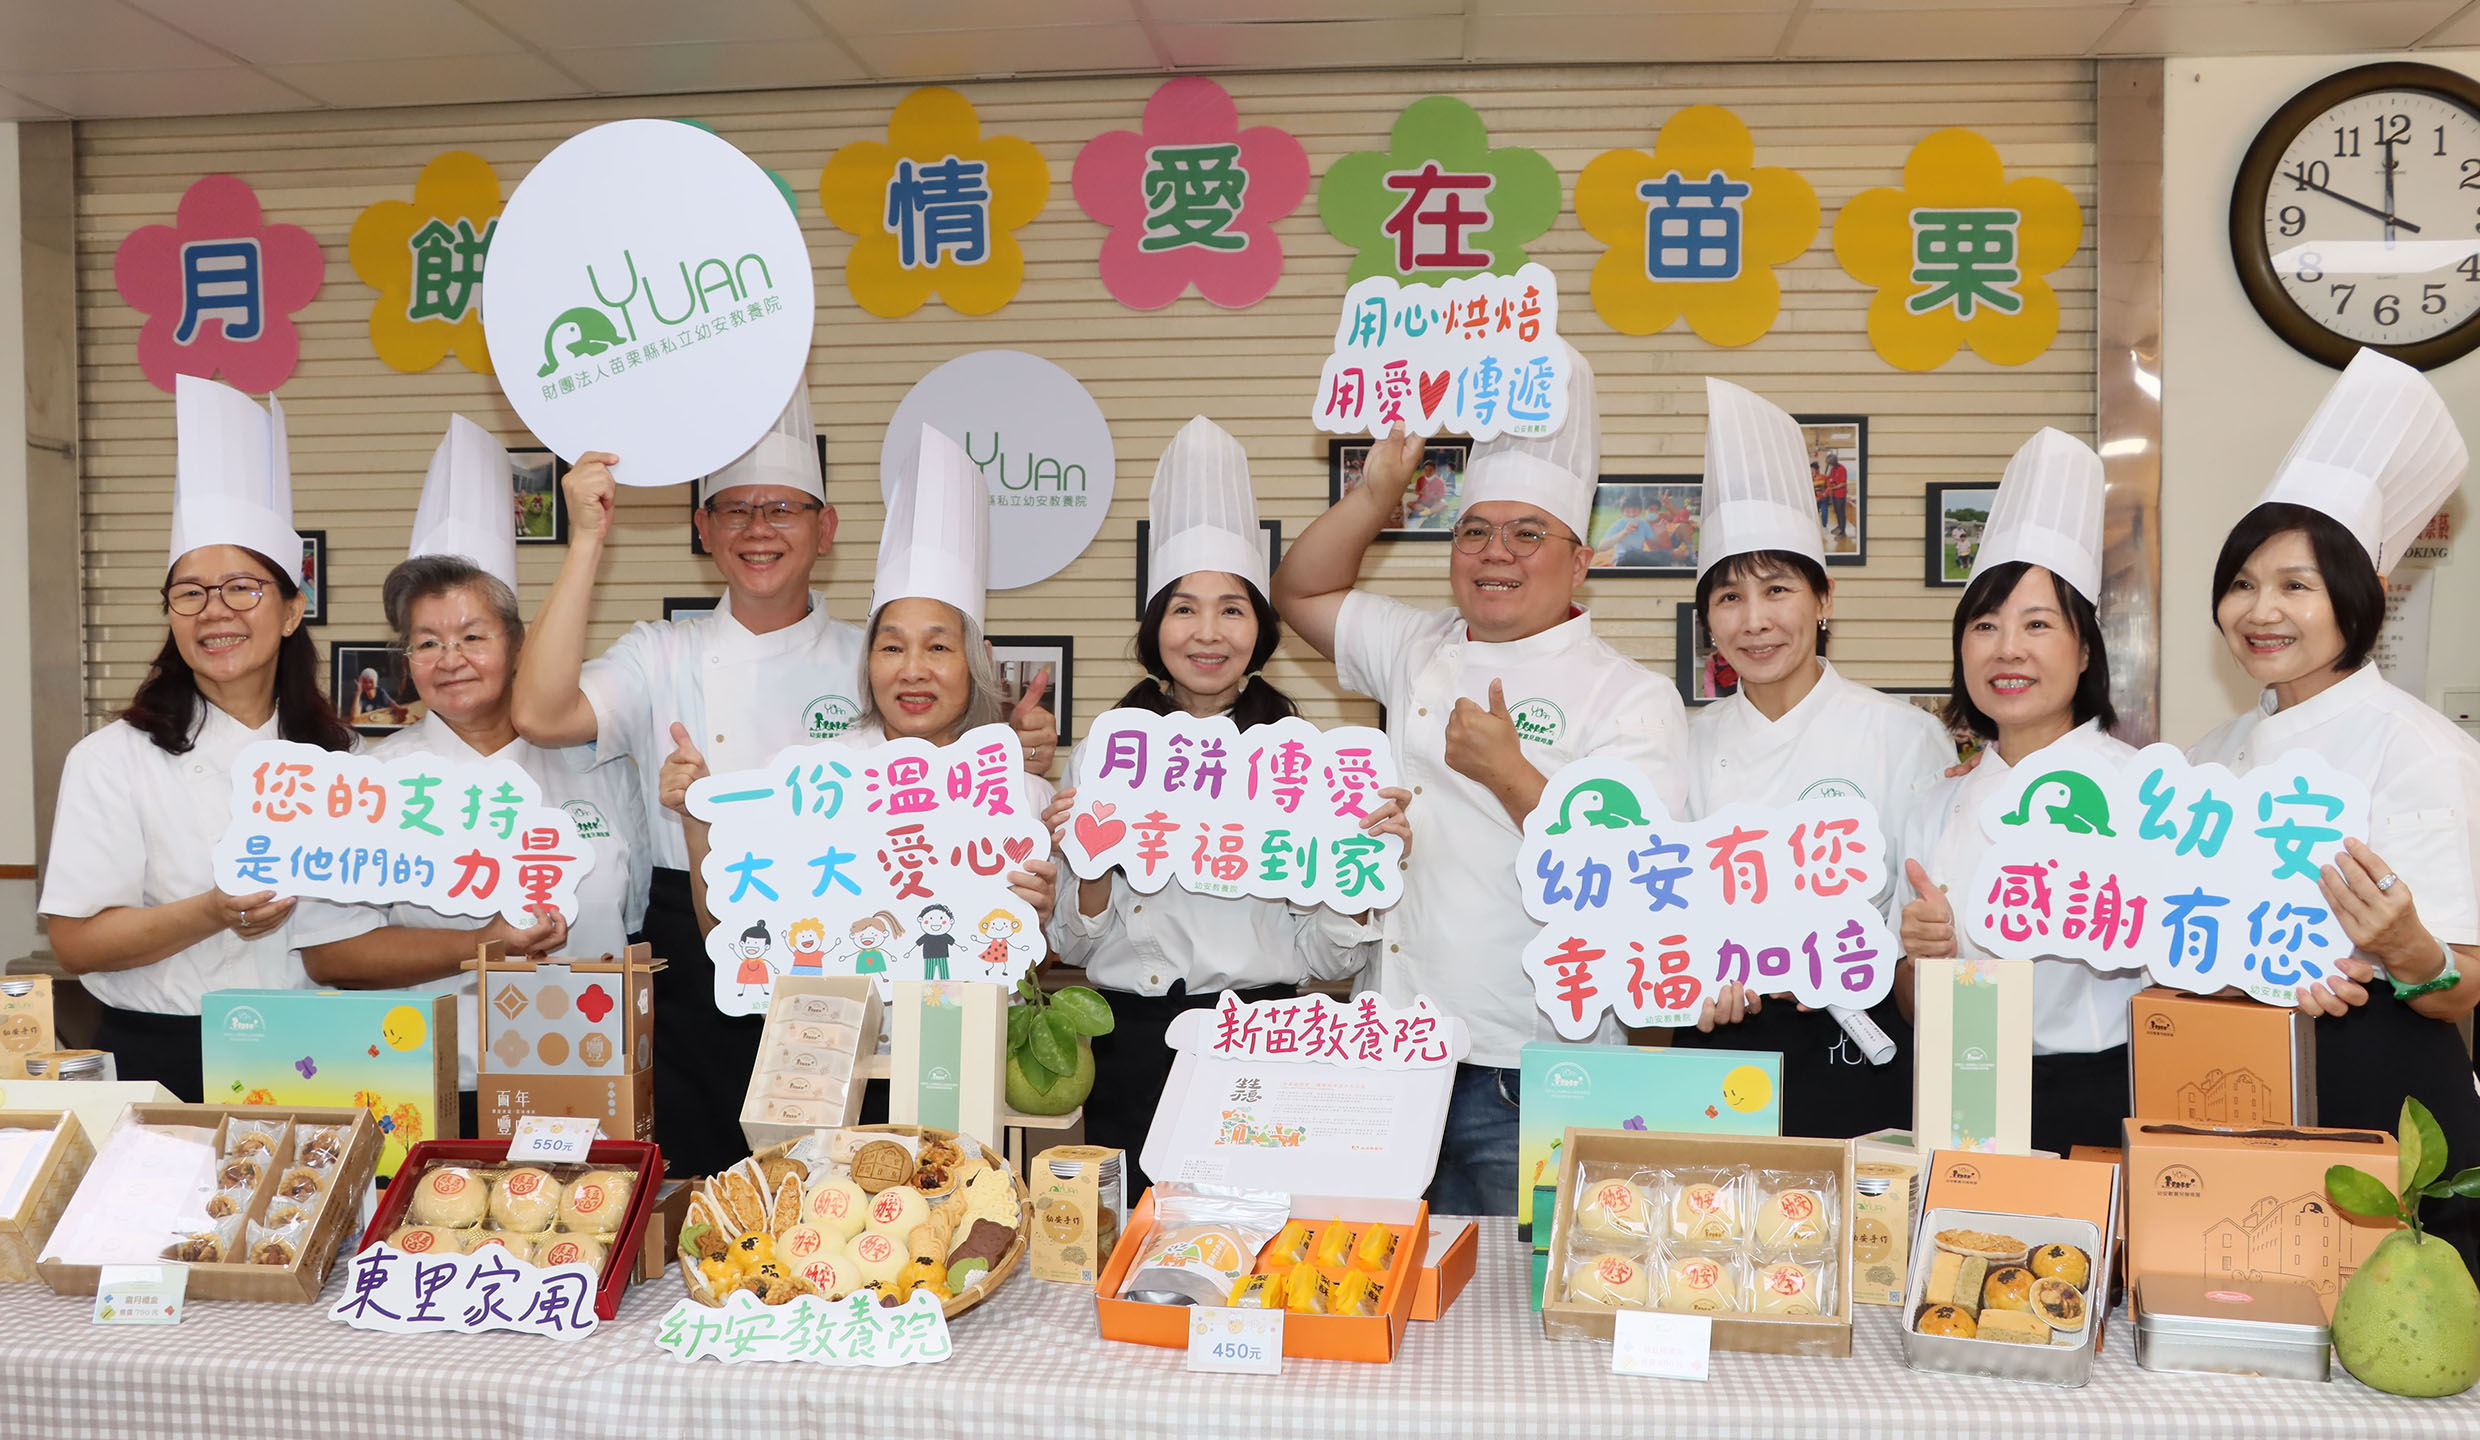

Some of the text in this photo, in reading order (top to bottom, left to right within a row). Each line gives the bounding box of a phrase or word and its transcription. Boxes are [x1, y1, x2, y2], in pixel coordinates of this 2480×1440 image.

[2334, 127, 2361, 157] 11
[2374, 114, 2411, 145] 12
[2433, 125, 2446, 156] 1
[2296, 160, 2329, 191] 10
[175, 145, 2022, 345] 月 餅 情 愛 在 苗 栗
[2280, 206, 2306, 236] 9
[2296, 252, 2323, 282] 8
[2330, 284, 2356, 314] 7
[2421, 284, 2446, 314] 5
[1348, 285, 1541, 349] 用心烘焙
[2373, 295, 2399, 325] 6
[541, 295, 783, 402] 財團法人苗栗縣私立幼安教養院
[2404, 547, 2448, 558] OKING
[252, 761, 524, 840] 您的支持
[708, 742, 1015, 820] 一份溫暖
[1099, 729, 1380, 819] 月餅傳愛
[1131, 809, 1386, 897] 幸福到家
[2138, 767, 2345, 881] 幼安
[235, 827, 577, 914] 是他們的力量
[724, 823, 1006, 903] 大大愛心
[1536, 818, 1868, 913] 幼安有您
[1984, 858, 2330, 988] 感謝有您
[1544, 919, 1879, 1023] 幸福加倍
[2250, 985, 2299, 1001] 幼安教養
[1213, 997, 1448, 1063] 新苗教養院
[496, 1089, 531, 1108] 百年
[532, 1138, 573, 1152] 550元
[337, 1247, 593, 1331] 東里家風
[660, 1295, 948, 1359] 幼安教養院
[1211, 1341, 1262, 1361] 450元
